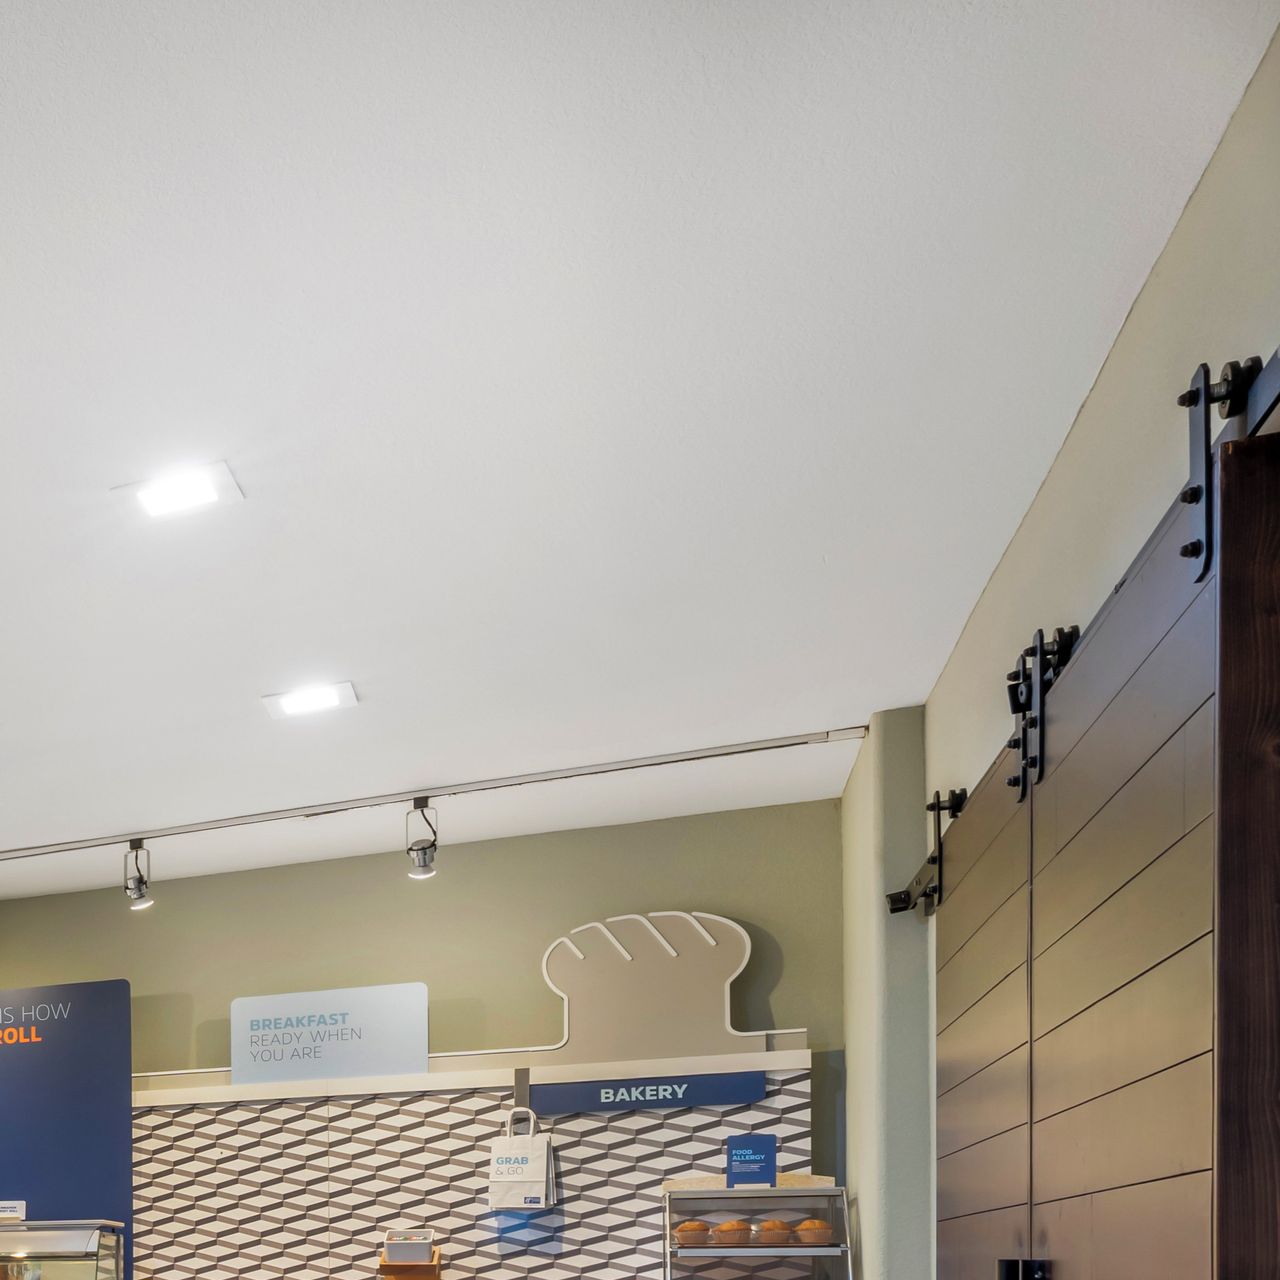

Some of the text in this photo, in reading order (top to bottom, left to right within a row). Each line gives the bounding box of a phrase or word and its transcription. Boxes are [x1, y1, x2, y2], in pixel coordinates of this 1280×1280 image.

[0, 1006, 15, 1024] IS
[21, 1002, 71, 1022] HOW
[249, 1012, 350, 1031] BREAKFAST
[250, 1027, 362, 1048] READY WHEN
[249, 1045, 322, 1062] YOU ARE
[600, 1084, 688, 1103] BAKERY
[496, 1156, 529, 1166] GRAB
[495, 1166, 524, 1176] & GO
